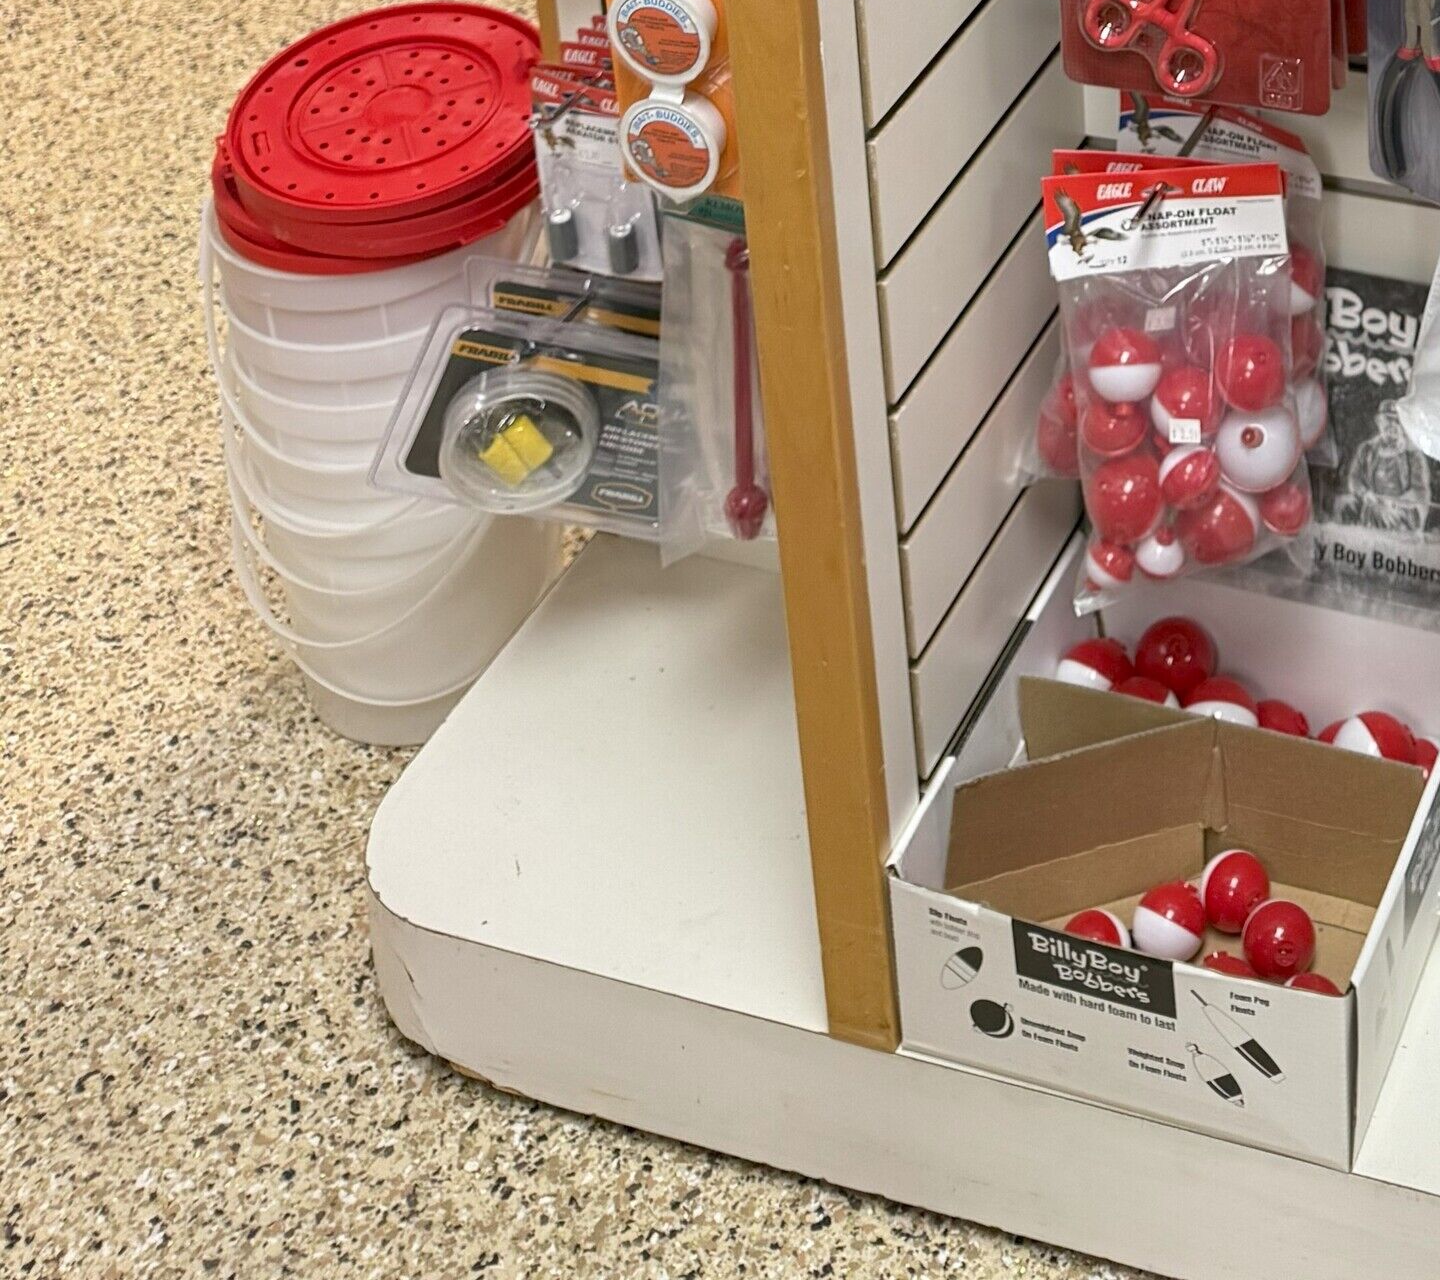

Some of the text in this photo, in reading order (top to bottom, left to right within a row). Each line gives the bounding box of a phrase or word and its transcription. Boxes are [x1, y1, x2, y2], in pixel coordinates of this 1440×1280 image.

[1096, 177, 1228, 201] EAGLE CLAW
[1200, 206, 1237, 217] FLOAT
[1141, 217, 1215, 231] ASSORTMENT
[1326, 287, 1418, 348] Boy
[1333, 543, 1367, 566] Boy
[1053, 963, 1150, 1005] Bobbers
[1018, 978, 1176, 1032] Made with hard foam to last
